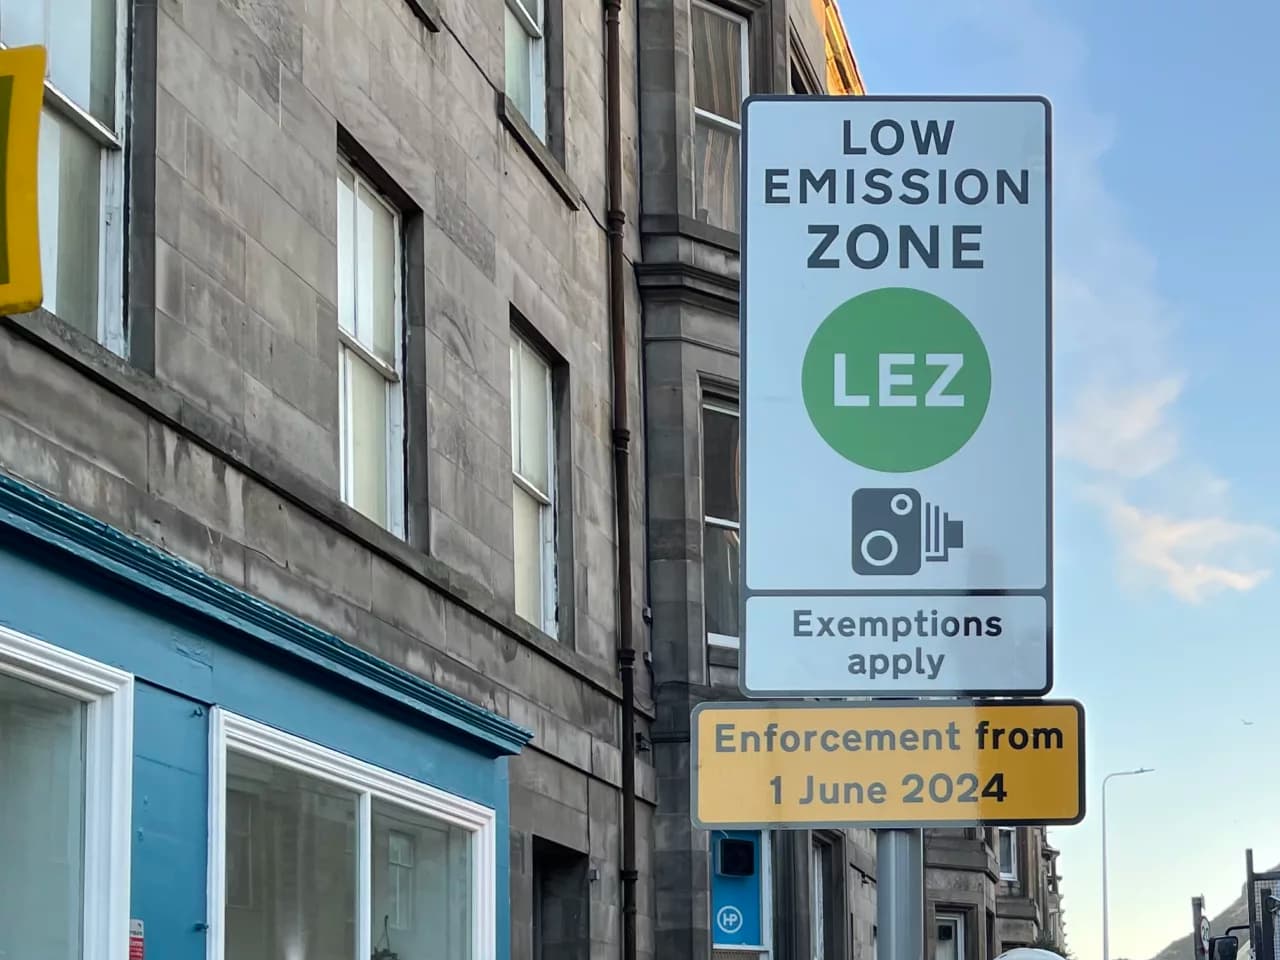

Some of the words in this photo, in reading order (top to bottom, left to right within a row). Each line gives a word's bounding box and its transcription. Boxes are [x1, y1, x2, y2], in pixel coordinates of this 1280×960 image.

[842, 119, 955, 156] LOW
[764, 168, 1029, 205] EMISSION
[806, 223, 984, 270] ZONE
[833, 353, 965, 407] LEZ
[792, 609, 1003, 642] Exemptions
[847, 646, 945, 680] apply
[714, 720, 961, 753] Enforcement
[975, 720, 1064, 750] from
[769, 775, 782, 805] 1
[798, 775, 887, 805] June
[901, 772, 1008, 803] 2024
